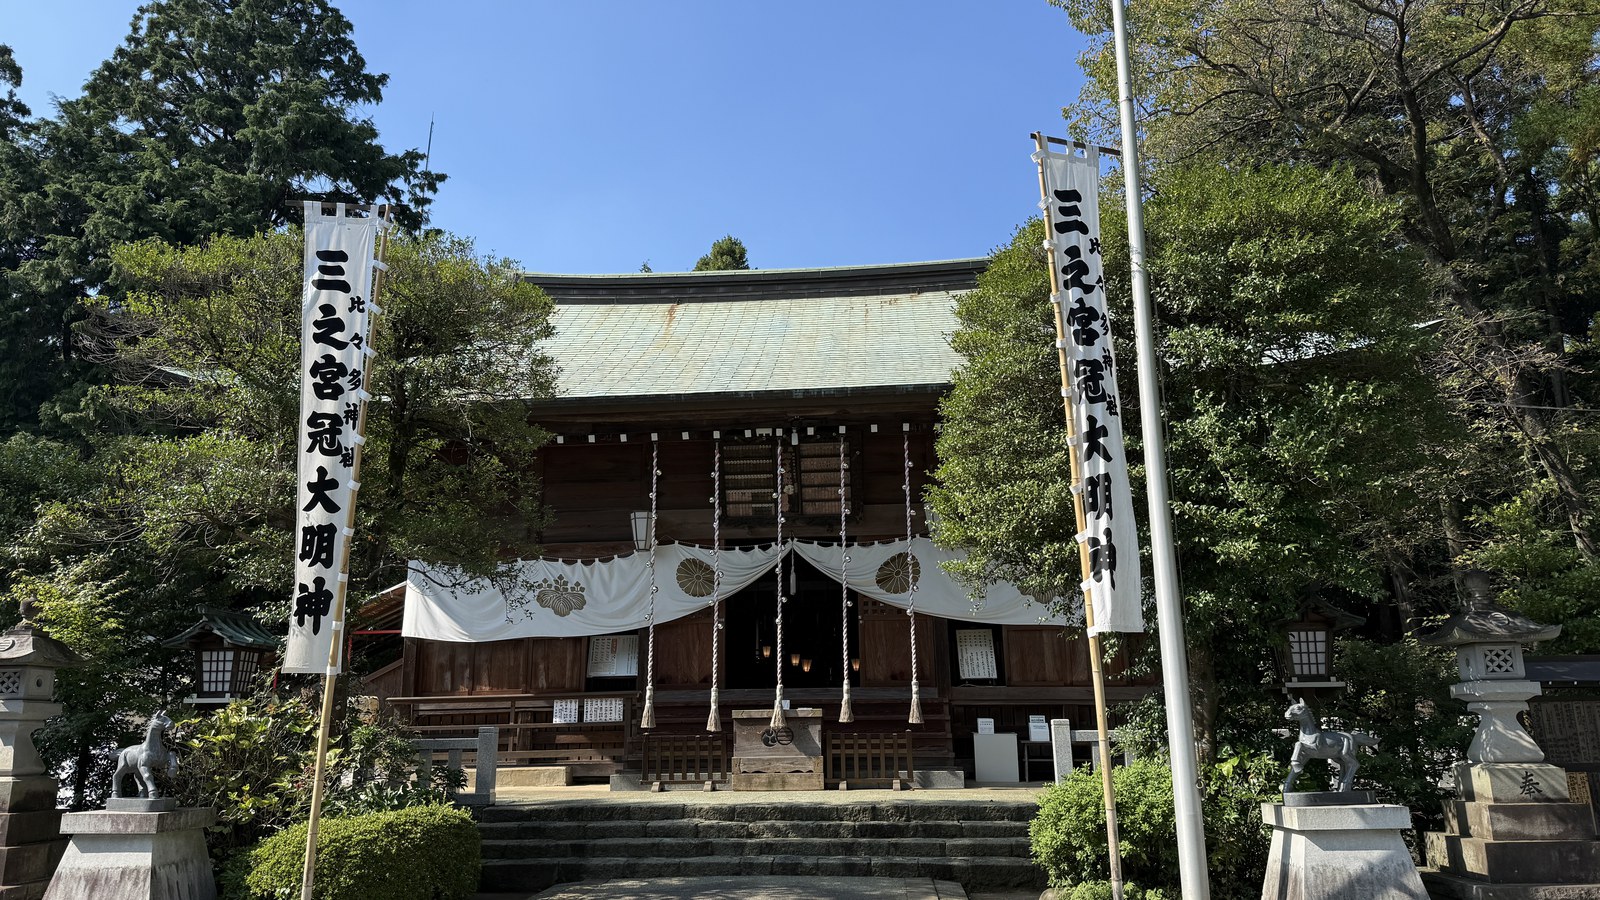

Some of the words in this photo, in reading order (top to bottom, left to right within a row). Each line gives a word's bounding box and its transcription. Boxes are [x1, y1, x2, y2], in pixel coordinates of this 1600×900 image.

[293, 249, 352, 636] 三之宮冠大明神
[1053, 188, 1117, 591] 三之宮冠大明神
[1519, 770, 1543, 799] 奉
